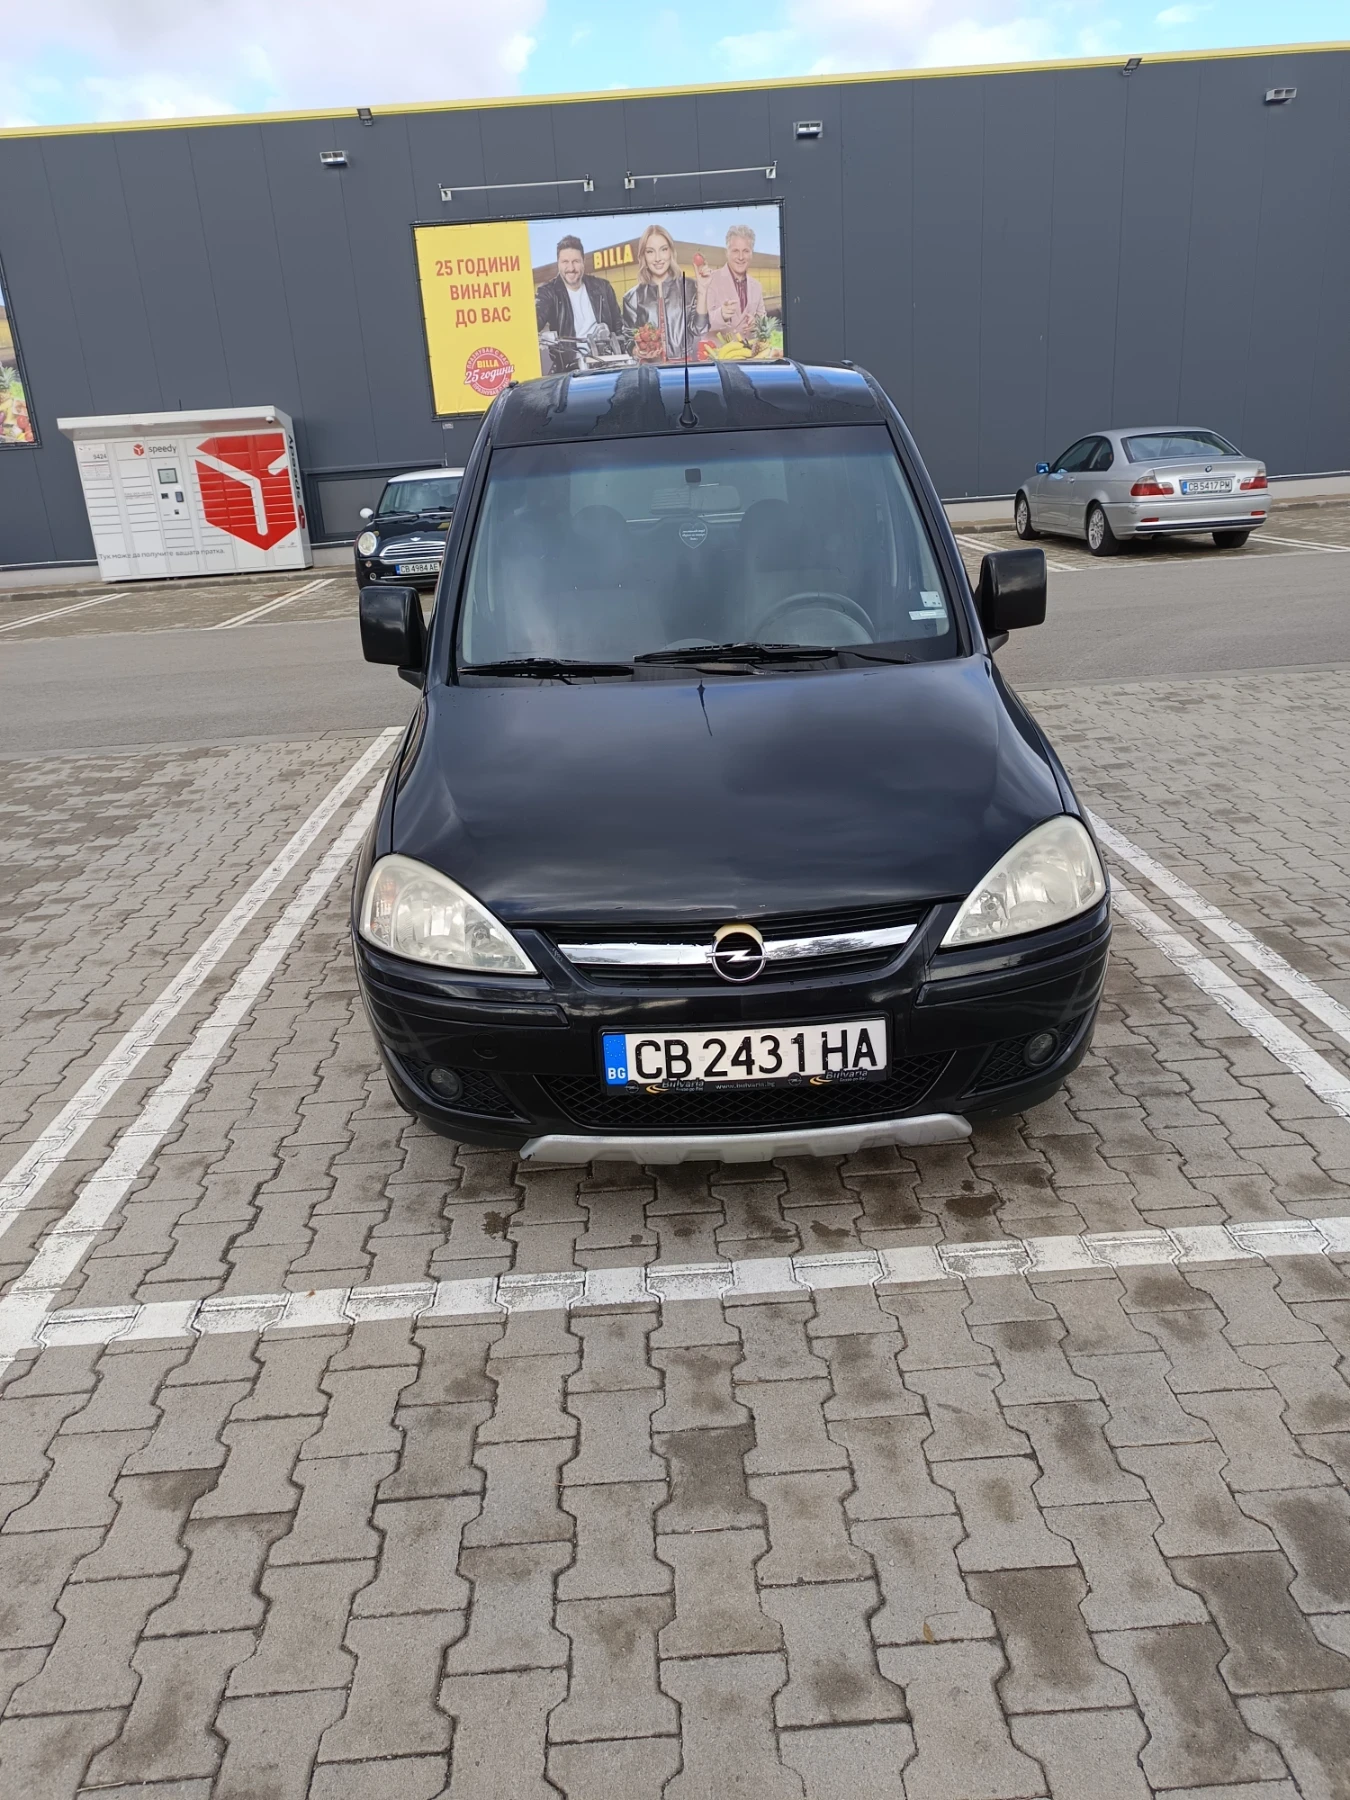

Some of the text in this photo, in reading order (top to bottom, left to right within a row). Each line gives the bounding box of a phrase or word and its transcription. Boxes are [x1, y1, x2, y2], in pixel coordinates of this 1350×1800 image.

[593, 243, 634, 270] BILLA
[435, 255, 520, 277] 25 ГОДИНИ
[449, 281, 511, 300] ВИНАГИ
[455, 306, 511, 328] ДО ВАС
[476, 359, 499, 368] BILLA
[464, 365, 514, 384] 25 години
[148, 444, 177, 454] speedy
[98, 553, 111, 561] Тук
[141, 550, 174, 558] получите
[634, 1027, 878, 1080] CB 2431 HA
[607, 1067, 626, 1080] BG
[826, 1069, 868, 1080] Bulvaria
[662, 1079, 704, 1089] Bulvaria
